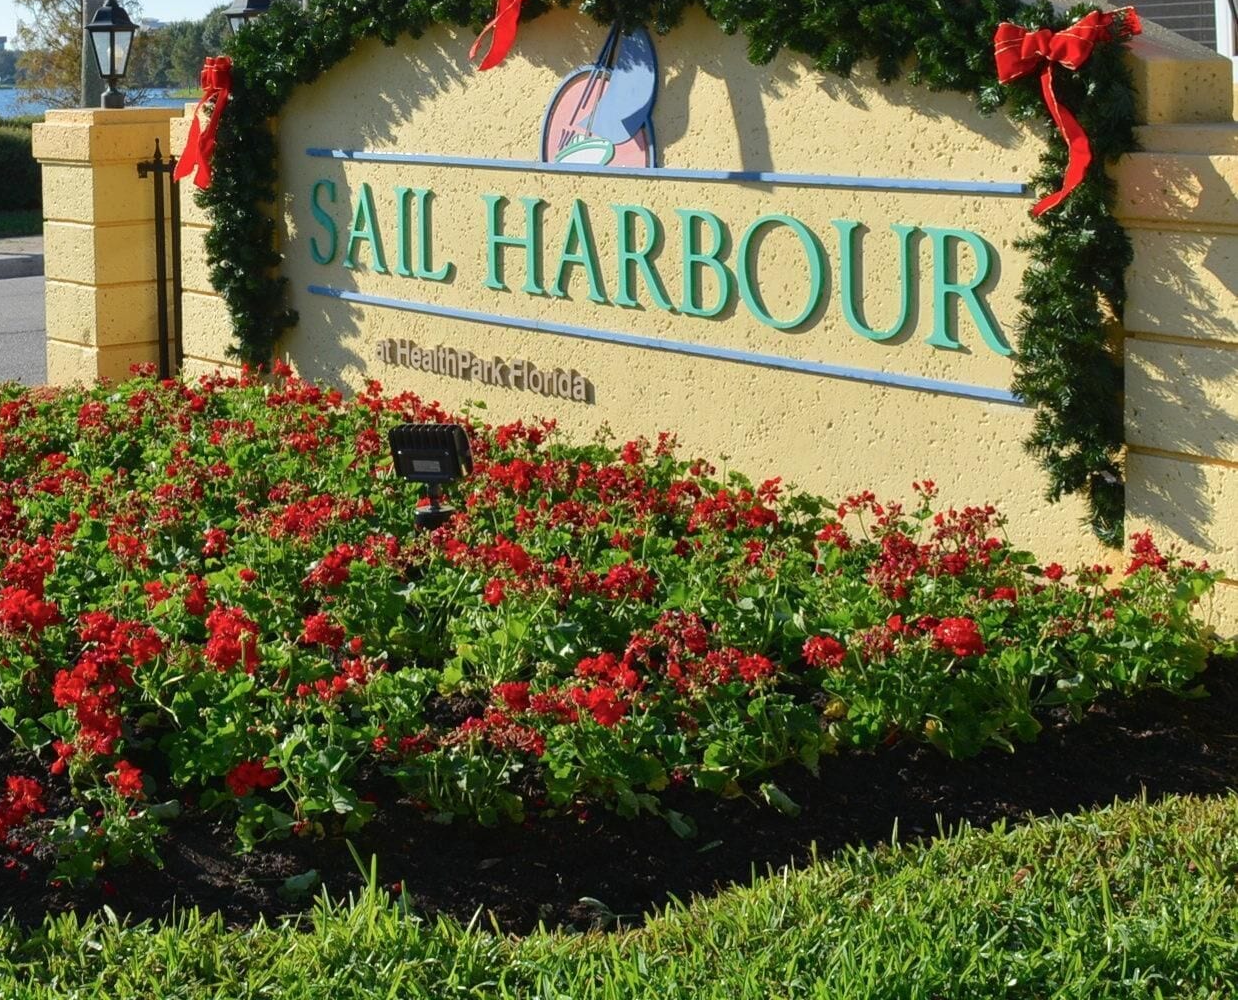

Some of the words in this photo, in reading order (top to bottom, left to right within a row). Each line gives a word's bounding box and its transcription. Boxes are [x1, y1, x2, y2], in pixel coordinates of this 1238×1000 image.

[309, 179, 453, 282] SAIL
[481, 192, 1013, 357] HARBOUR
[375, 339, 393, 363] at
[396, 340, 504, 387] HealthPark
[509, 359, 587, 401] Florida
